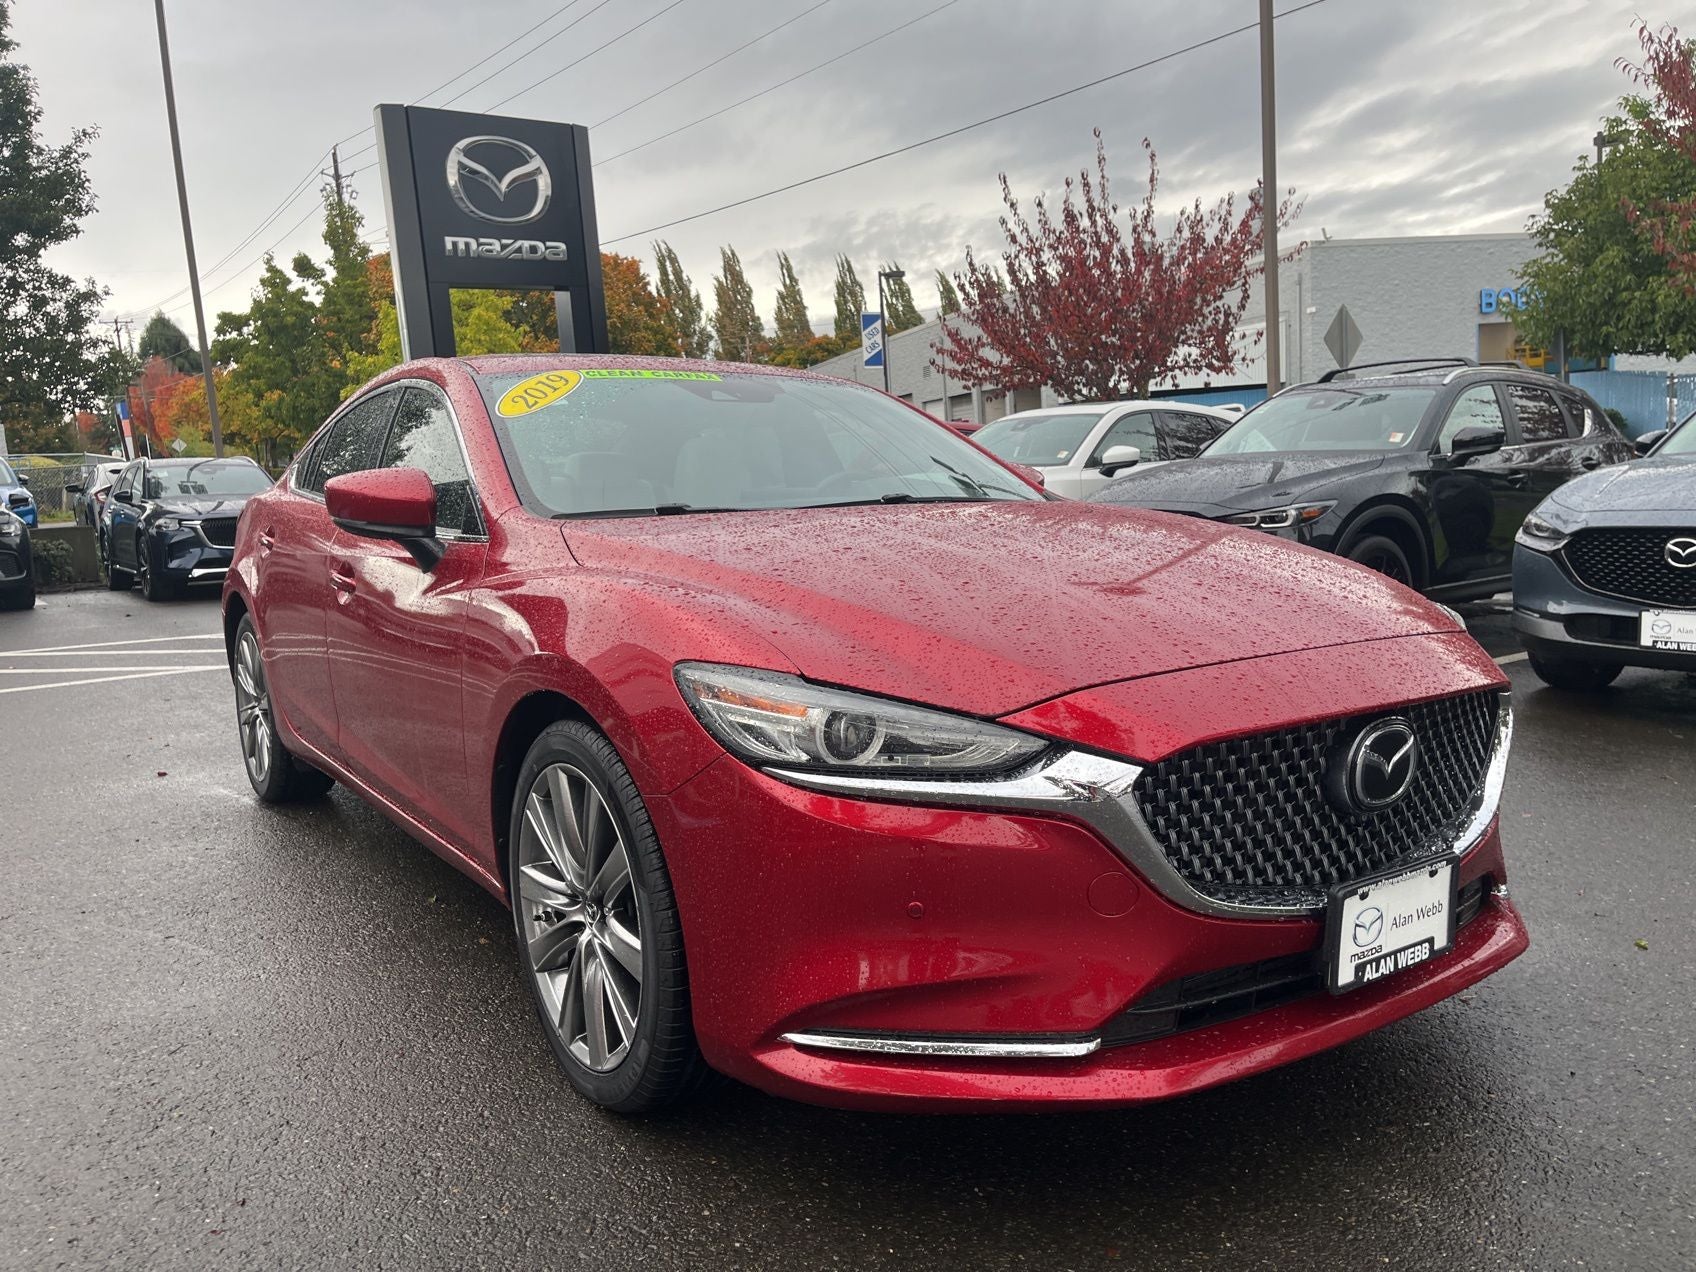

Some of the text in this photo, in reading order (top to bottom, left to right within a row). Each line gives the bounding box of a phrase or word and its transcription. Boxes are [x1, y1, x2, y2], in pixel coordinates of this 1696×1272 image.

[865, 326, 880, 340] USED
[865, 340, 881, 354] CARS
[511, 374, 570, 409] 2019
[1656, 641, 1678, 650] ALAN
[1390, 900, 1443, 931] Alan Webb
[1363, 942, 1430, 982] ALAN WEBB
